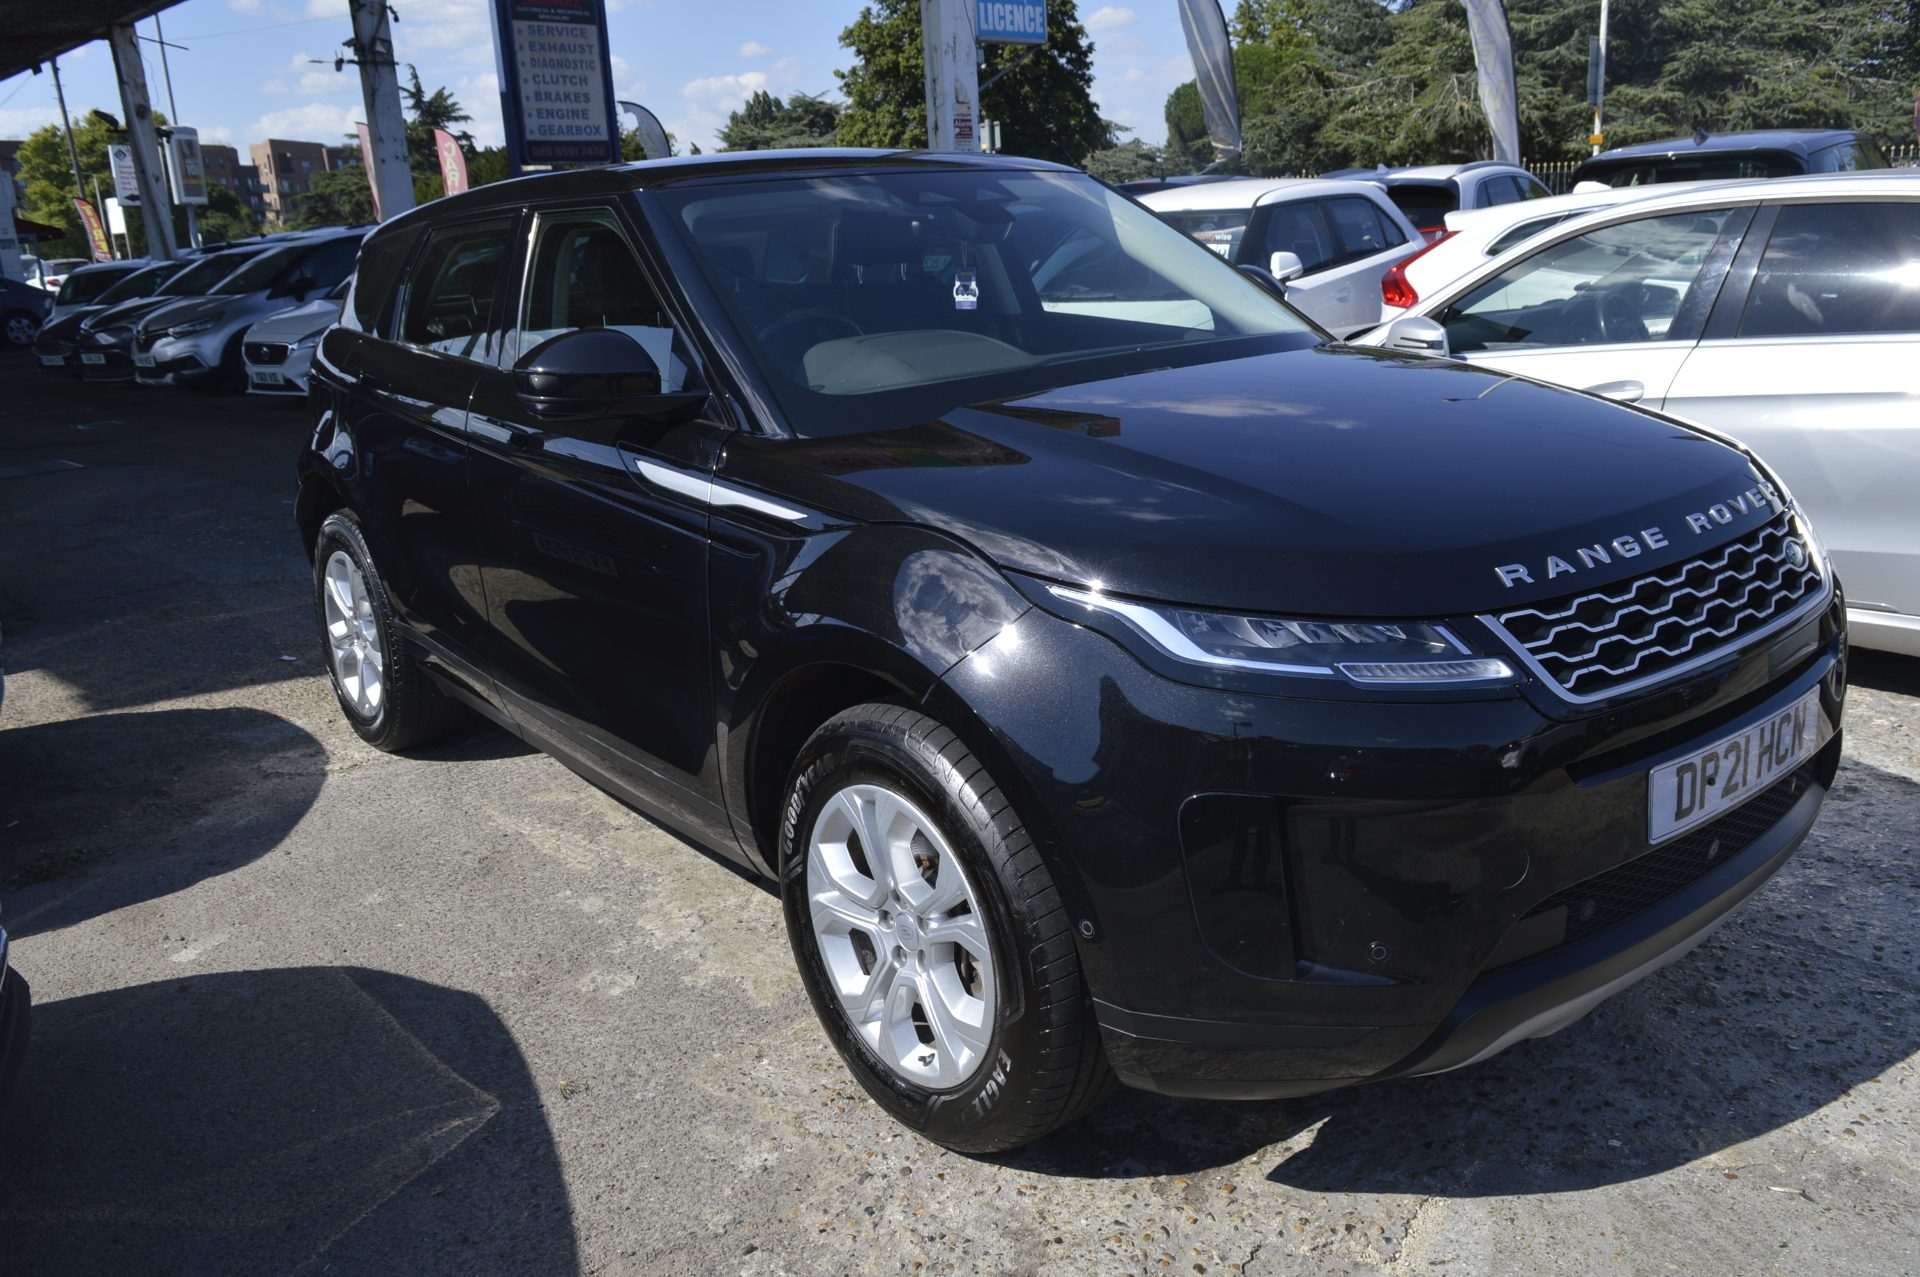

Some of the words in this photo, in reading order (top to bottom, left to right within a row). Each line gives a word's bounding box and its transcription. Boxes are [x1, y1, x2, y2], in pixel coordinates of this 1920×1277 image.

[979, 2, 1044, 33] LICENCE
[527, 24, 589, 39] SERVICE
[528, 41, 594, 55] EXHAUST
[530, 57, 596, 71] DIAGNOSTIC
[532, 74, 589, 87] CLUTCH
[534, 91, 591, 104] BRAKES
[536, 108, 590, 121] ENGINE
[538, 124, 602, 137] GEARBOX
[1495, 527, 1669, 588] RANGE
[1685, 480, 1778, 535] ROVER
[1675, 735, 1750, 822] DP21
[783, 752, 834, 855] GOODYEAR
